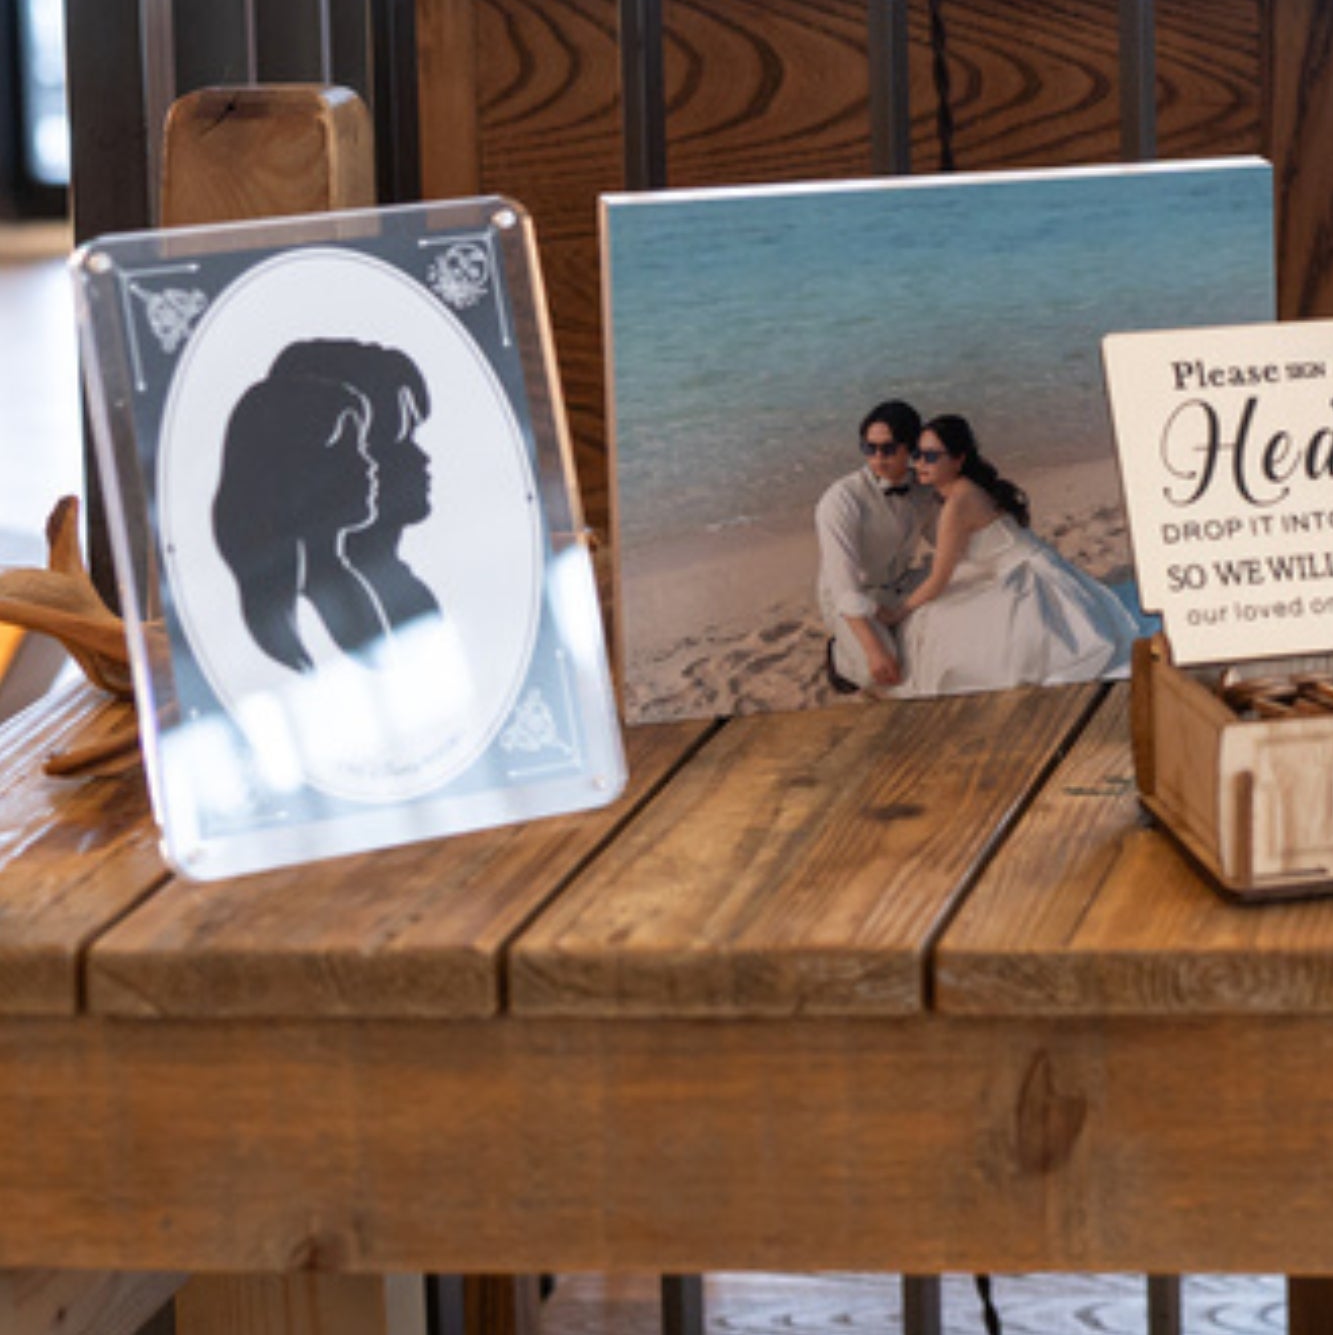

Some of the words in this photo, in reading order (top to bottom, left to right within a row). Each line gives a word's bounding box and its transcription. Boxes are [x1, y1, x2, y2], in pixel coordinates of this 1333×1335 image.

[1171, 358, 1280, 390] Please
[1162, 518, 1243, 545] DROP
[1250, 514, 1274, 537] IT
[1167, 563, 1208, 593] SO
[1213, 558, 1264, 586] WE
[1187, 605, 1228, 626] our
[1233, 596, 1304, 621] loved
